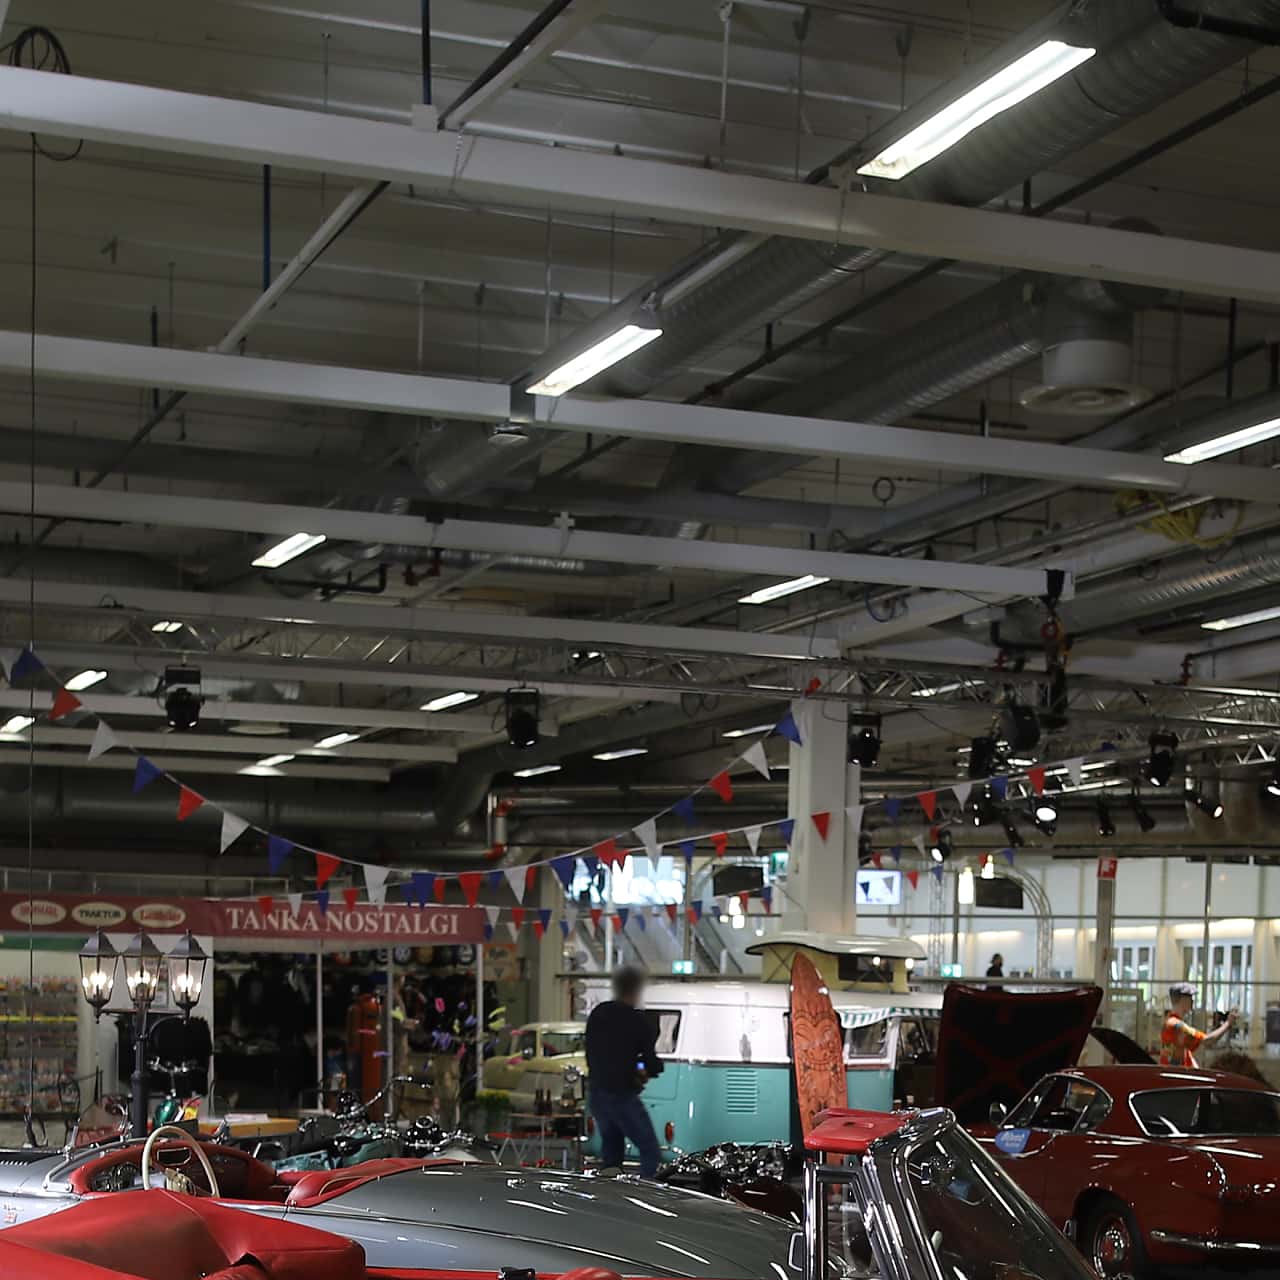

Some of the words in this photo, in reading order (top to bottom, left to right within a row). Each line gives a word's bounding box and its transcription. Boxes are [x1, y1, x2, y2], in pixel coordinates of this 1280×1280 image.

[79, 910, 121, 919] TRAKTOR
[226, 907, 318, 932] TANKA
[325, 910, 459, 935] NOSTALGI
